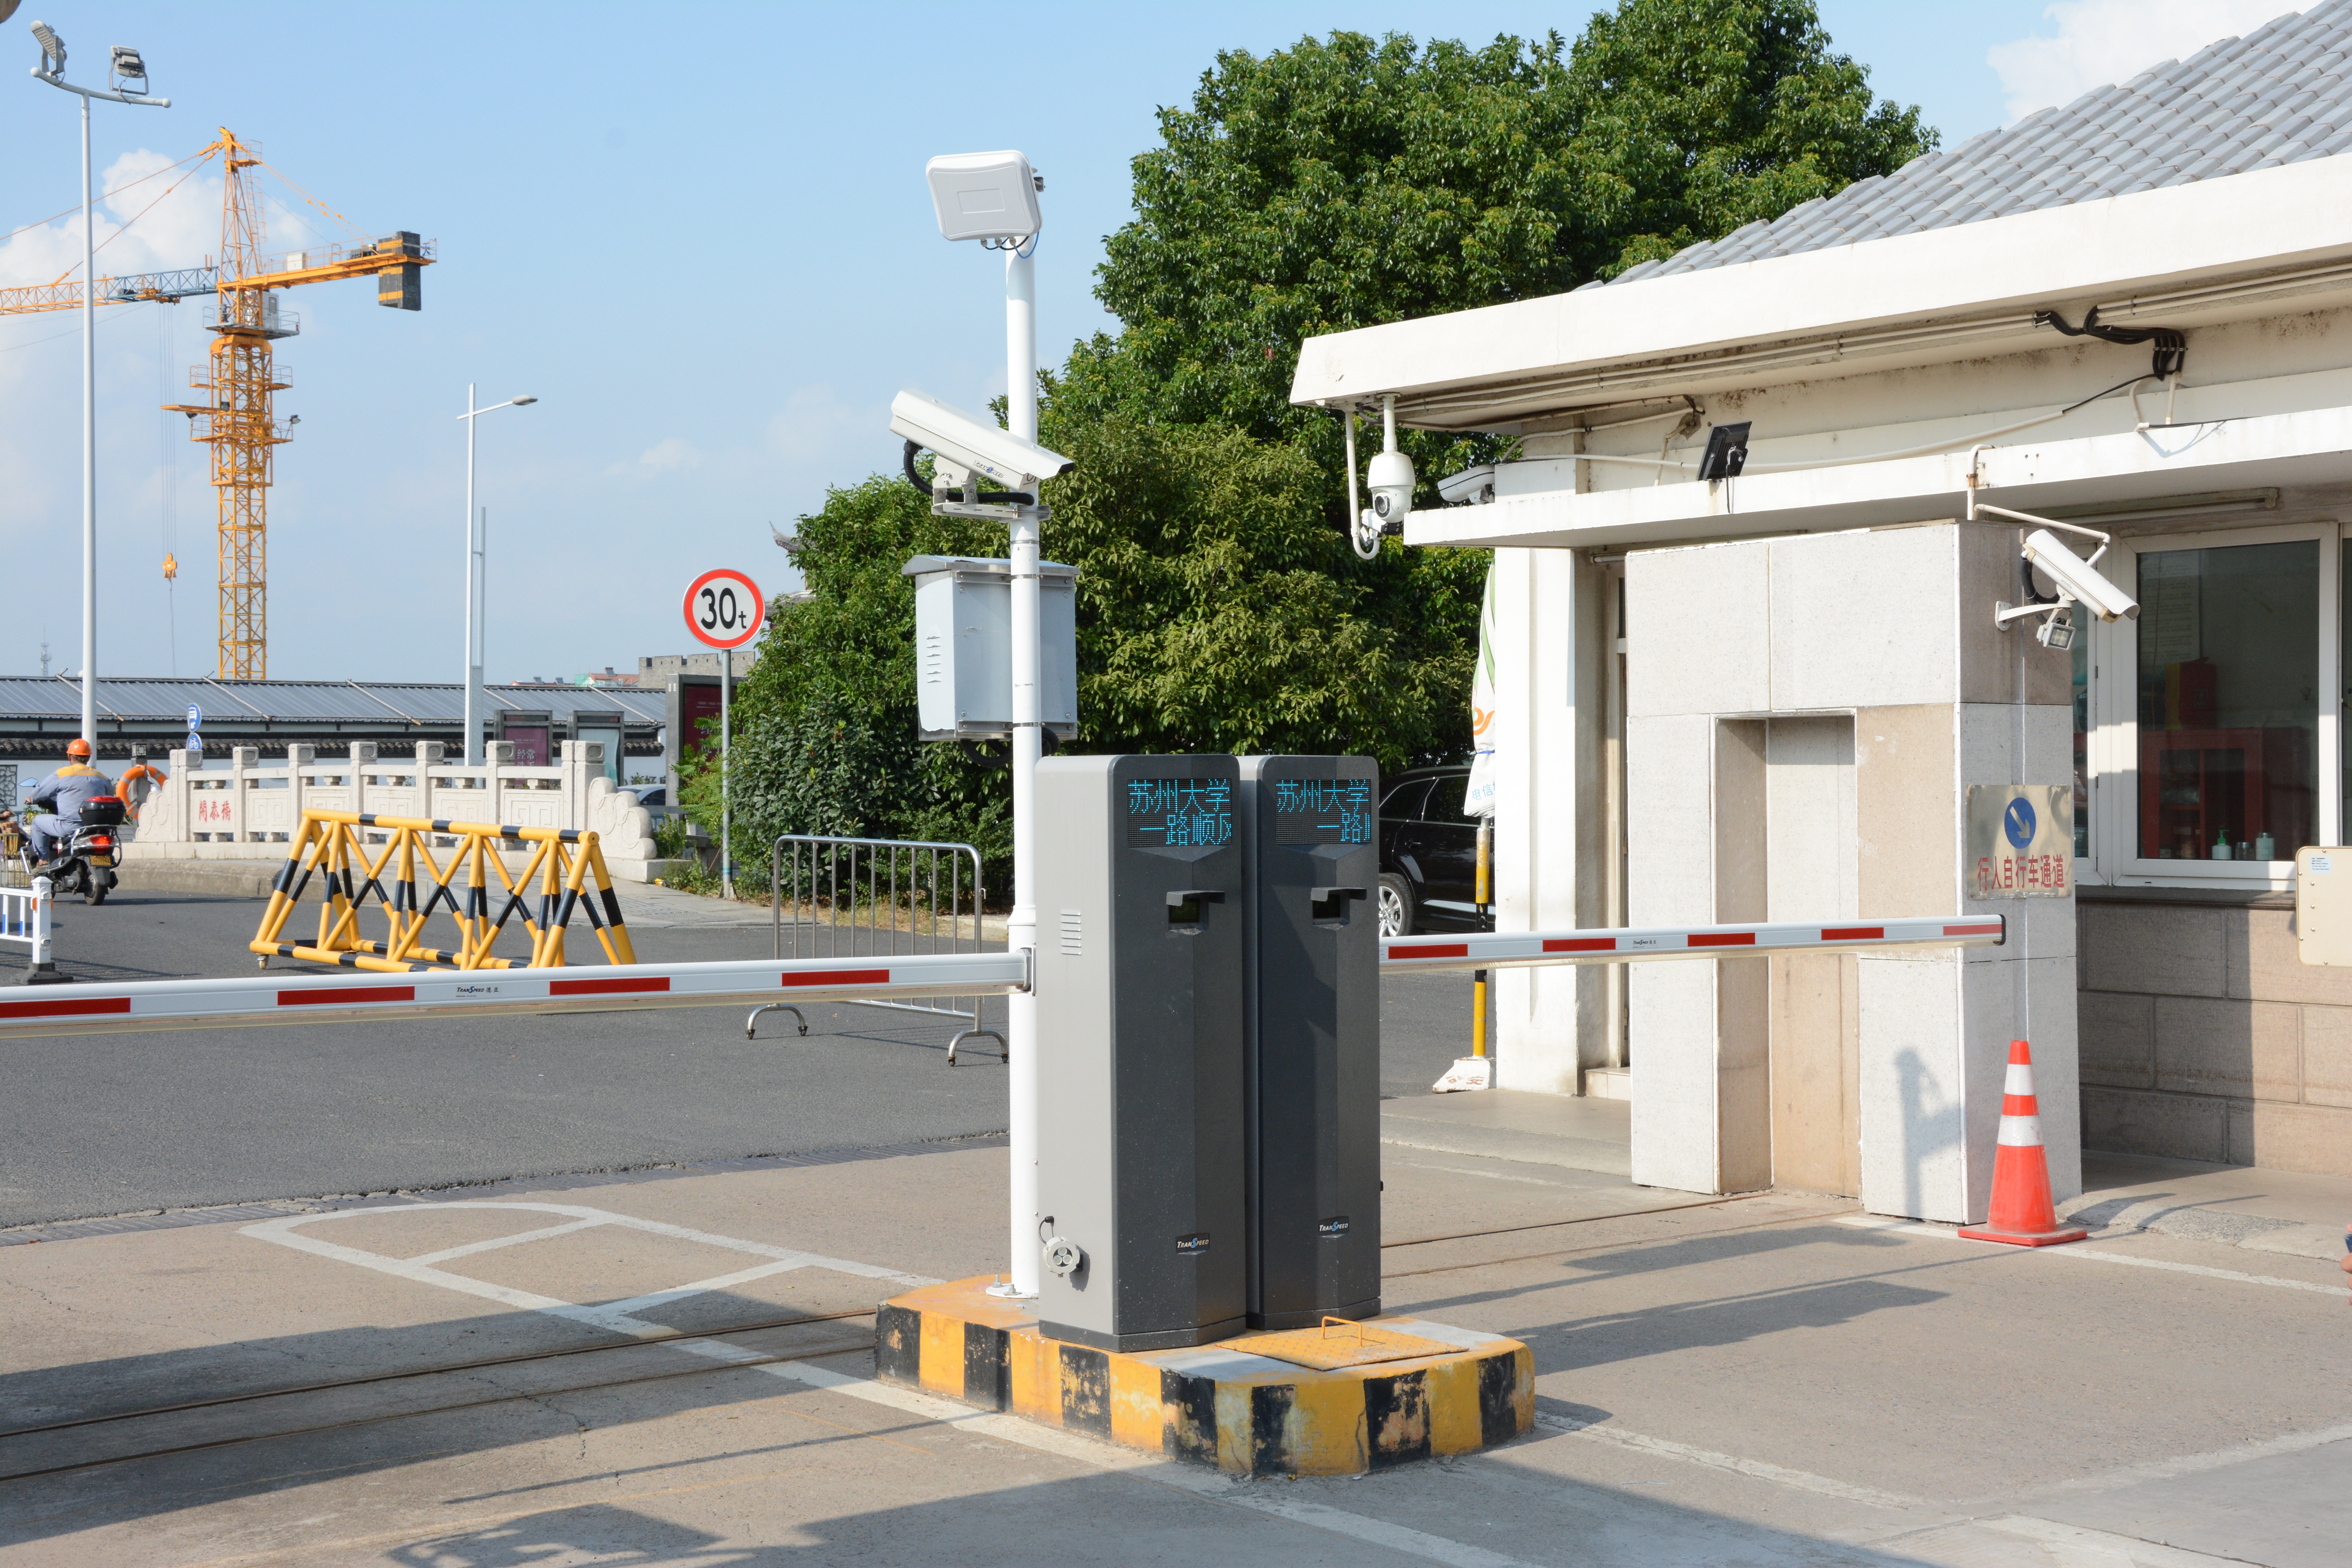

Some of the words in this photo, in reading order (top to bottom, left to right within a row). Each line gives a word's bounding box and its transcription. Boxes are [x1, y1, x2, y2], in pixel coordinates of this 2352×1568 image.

[701, 588, 747, 630] 30t
[517, 749, 535, 760] 经常
[1127, 779, 1230, 813] 苏州大学
[1276, 779, 1369, 812] 苏州大学
[1472, 781, 1495, 800] 电信
[1978, 855, 2065, 891] 行人自行车通道
[1319, 1221, 1348, 1232] TRANSPEED
[1177, 1238, 1209, 1249] TRANSPEED
